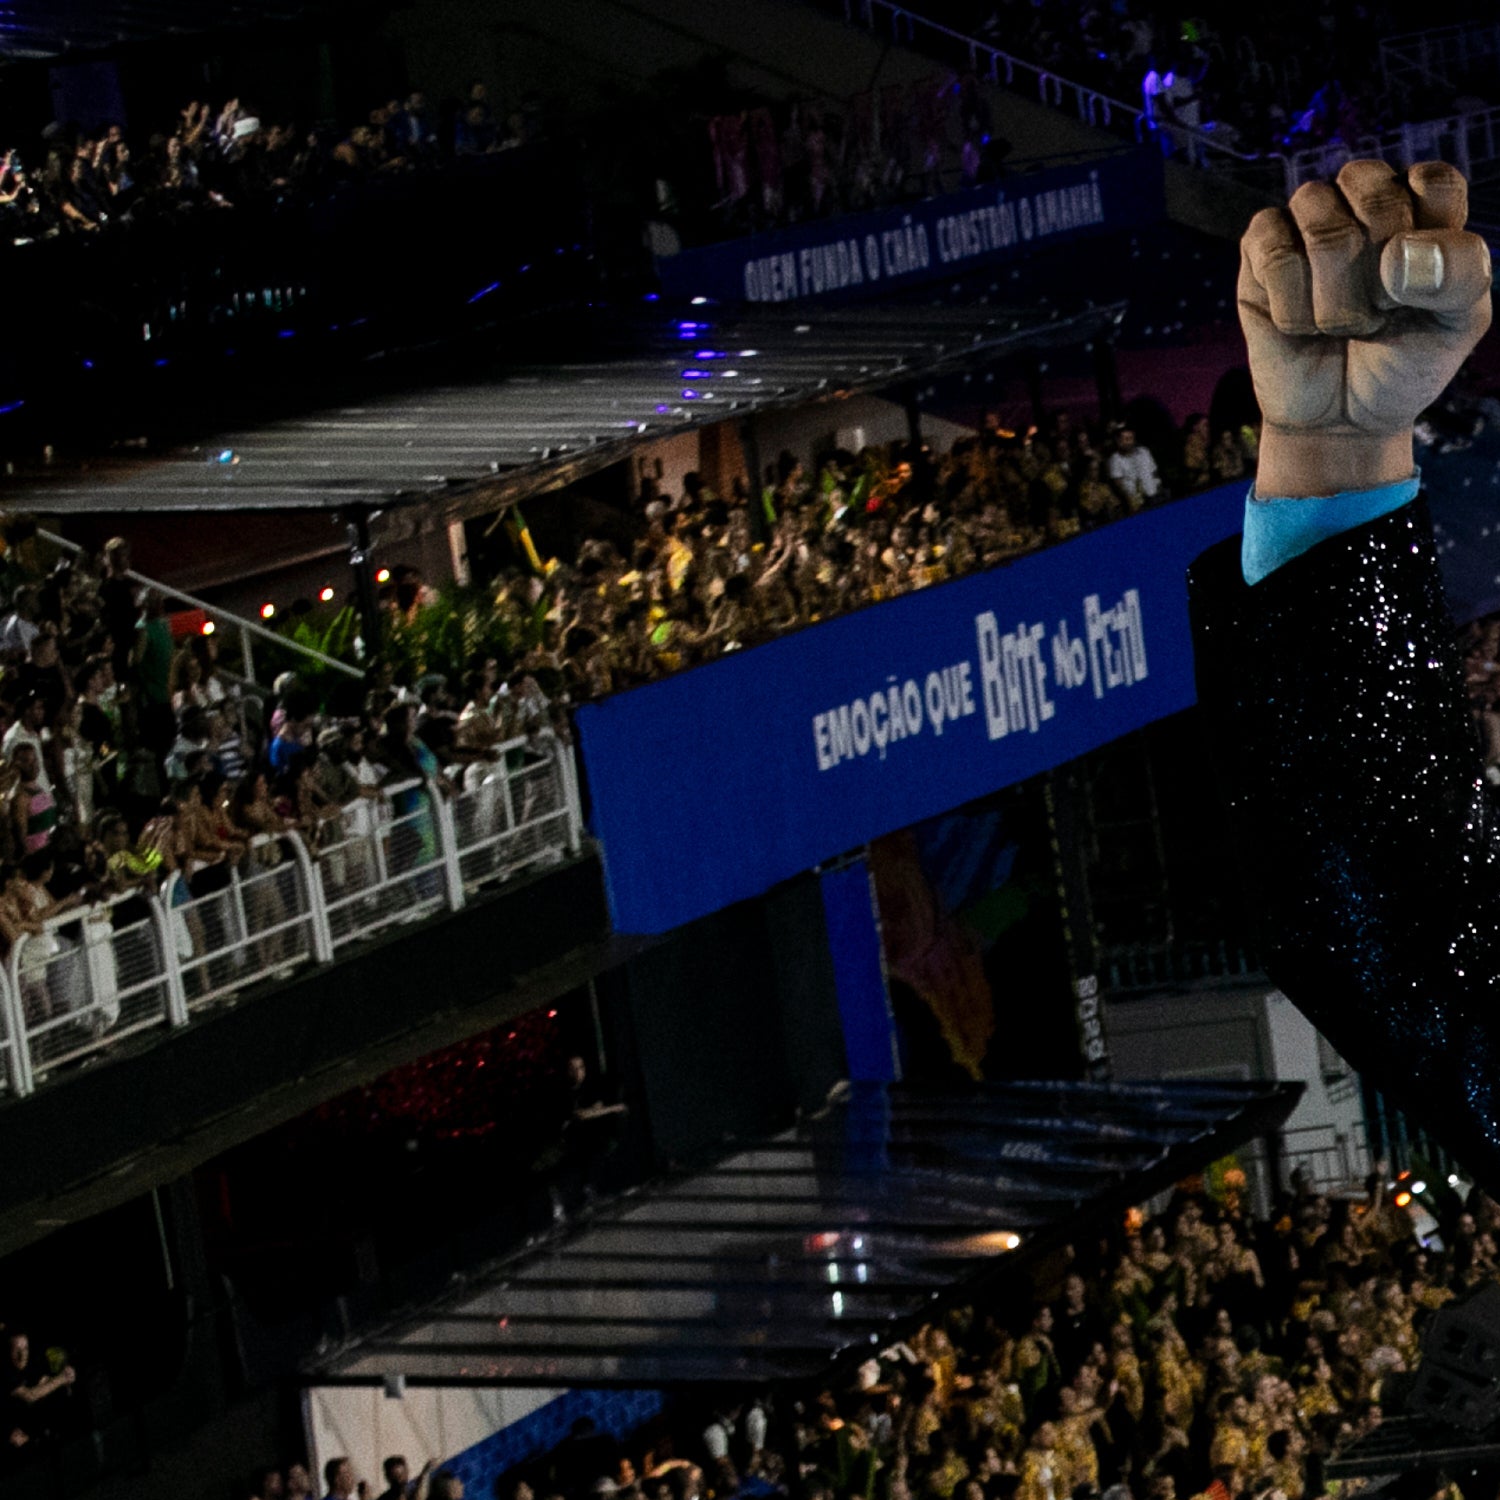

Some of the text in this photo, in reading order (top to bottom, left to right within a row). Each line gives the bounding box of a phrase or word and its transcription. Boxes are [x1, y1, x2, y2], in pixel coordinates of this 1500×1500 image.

[744, 169, 1105, 302] QUEM FUNDA O CHÃO CONSTRÓI O AMANHÃ
[812, 674, 923, 772] EMOÇÃO
[925, 660, 977, 736] QUE
[975, 609, 1055, 741] BATE
